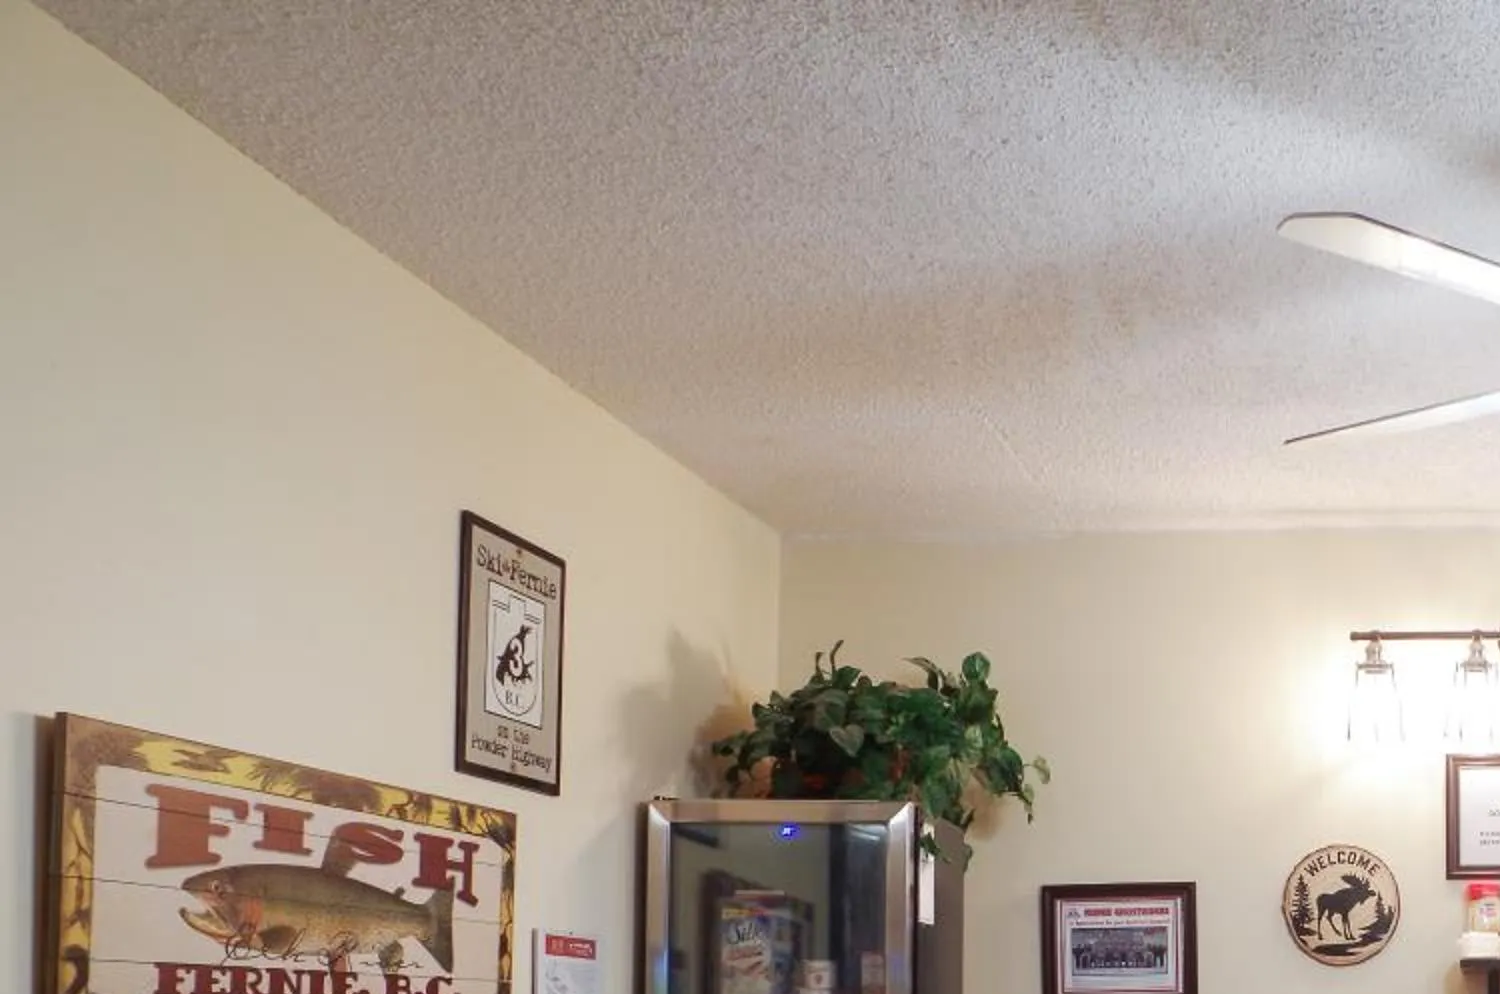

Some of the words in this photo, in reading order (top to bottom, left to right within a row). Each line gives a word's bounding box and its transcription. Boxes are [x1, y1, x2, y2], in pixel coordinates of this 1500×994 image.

[476, 543, 503, 577] Ski
[510, 559, 556, 600] Fernie
[508, 638, 523, 677] 3
[472, 735, 508, 758] Powder
[144, 783, 481, 907] FISH
[1303, 851, 1381, 877] WELCOME
